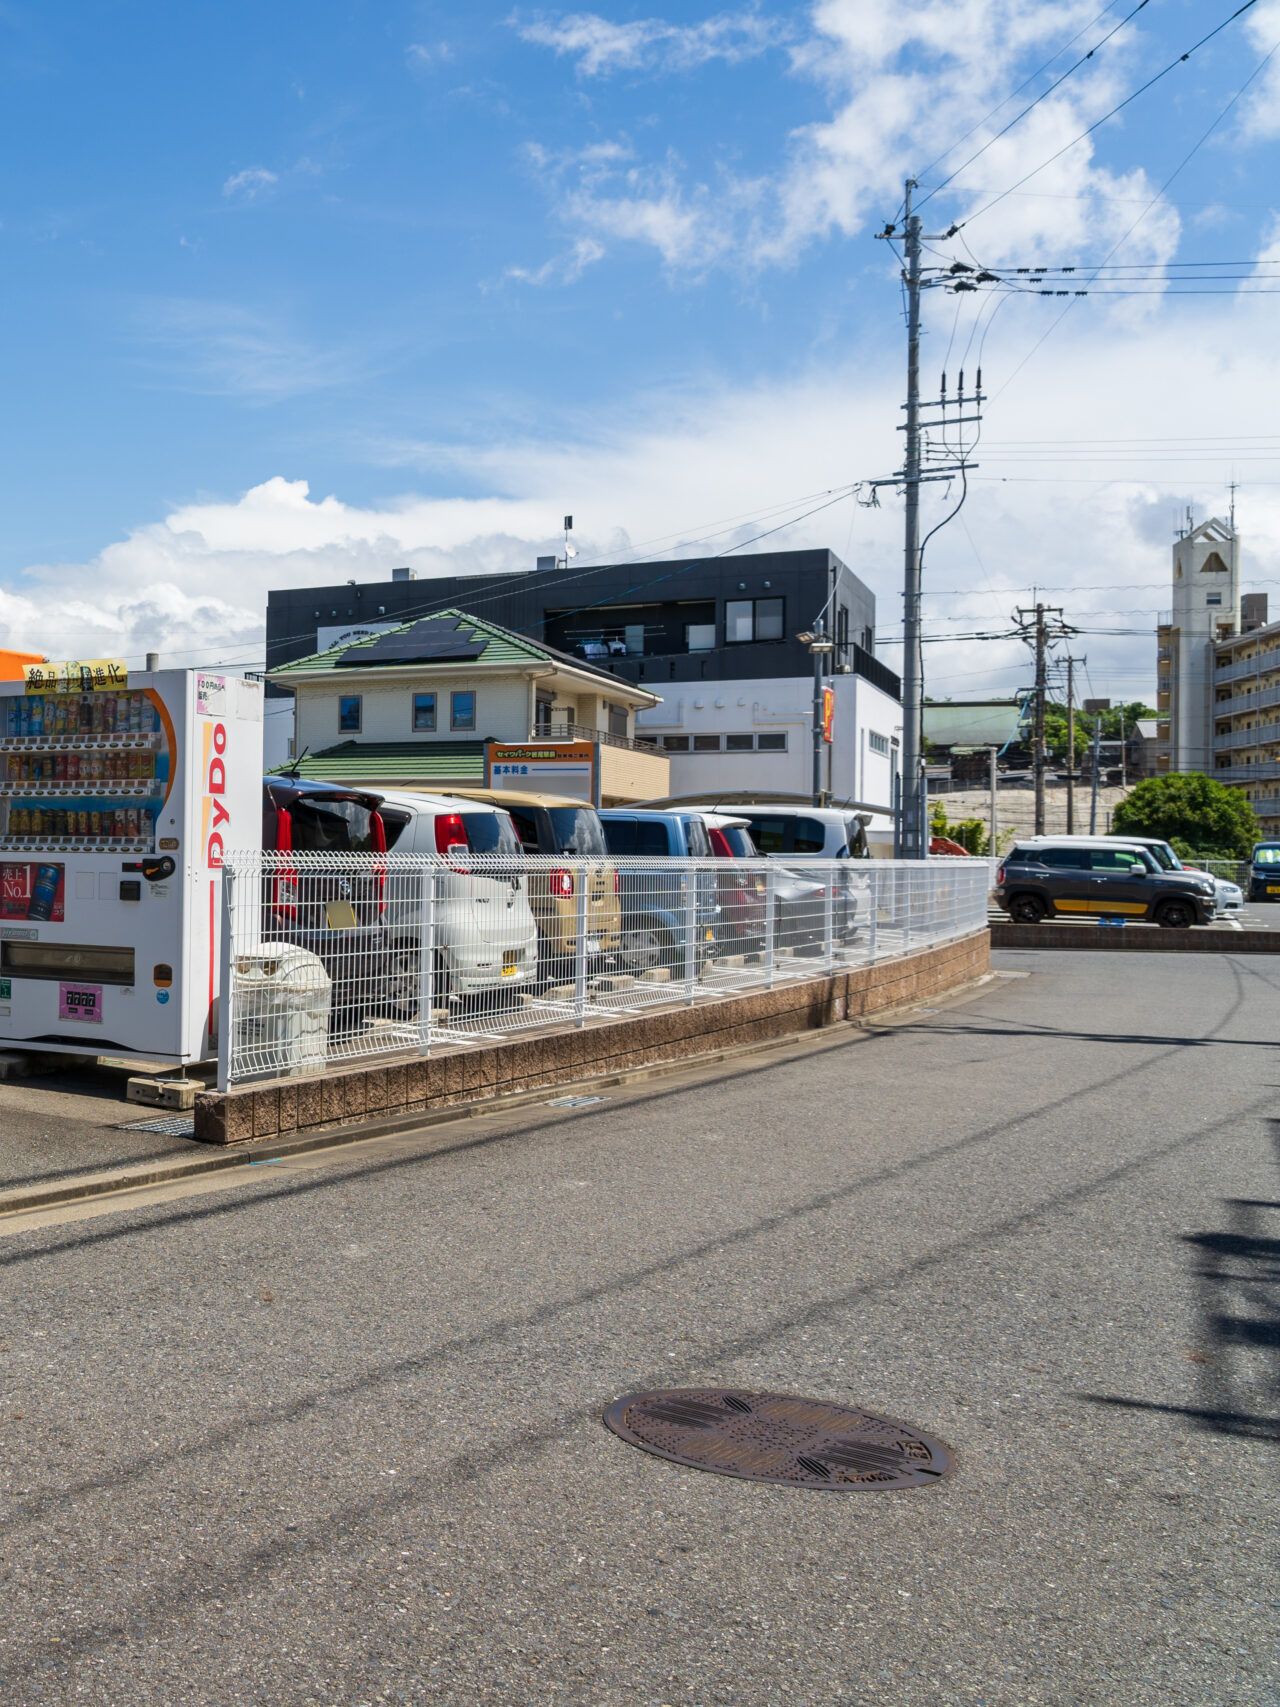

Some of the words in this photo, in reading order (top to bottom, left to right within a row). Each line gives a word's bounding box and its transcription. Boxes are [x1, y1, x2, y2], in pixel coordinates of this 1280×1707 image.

[27, 668, 57, 690] 絶品
[93, 663, 124, 686] 進化
[494, 765, 528, 775] 基本料金
[3, 868, 23, 881] 売上
[67, 994, 95, 1006] 7777
